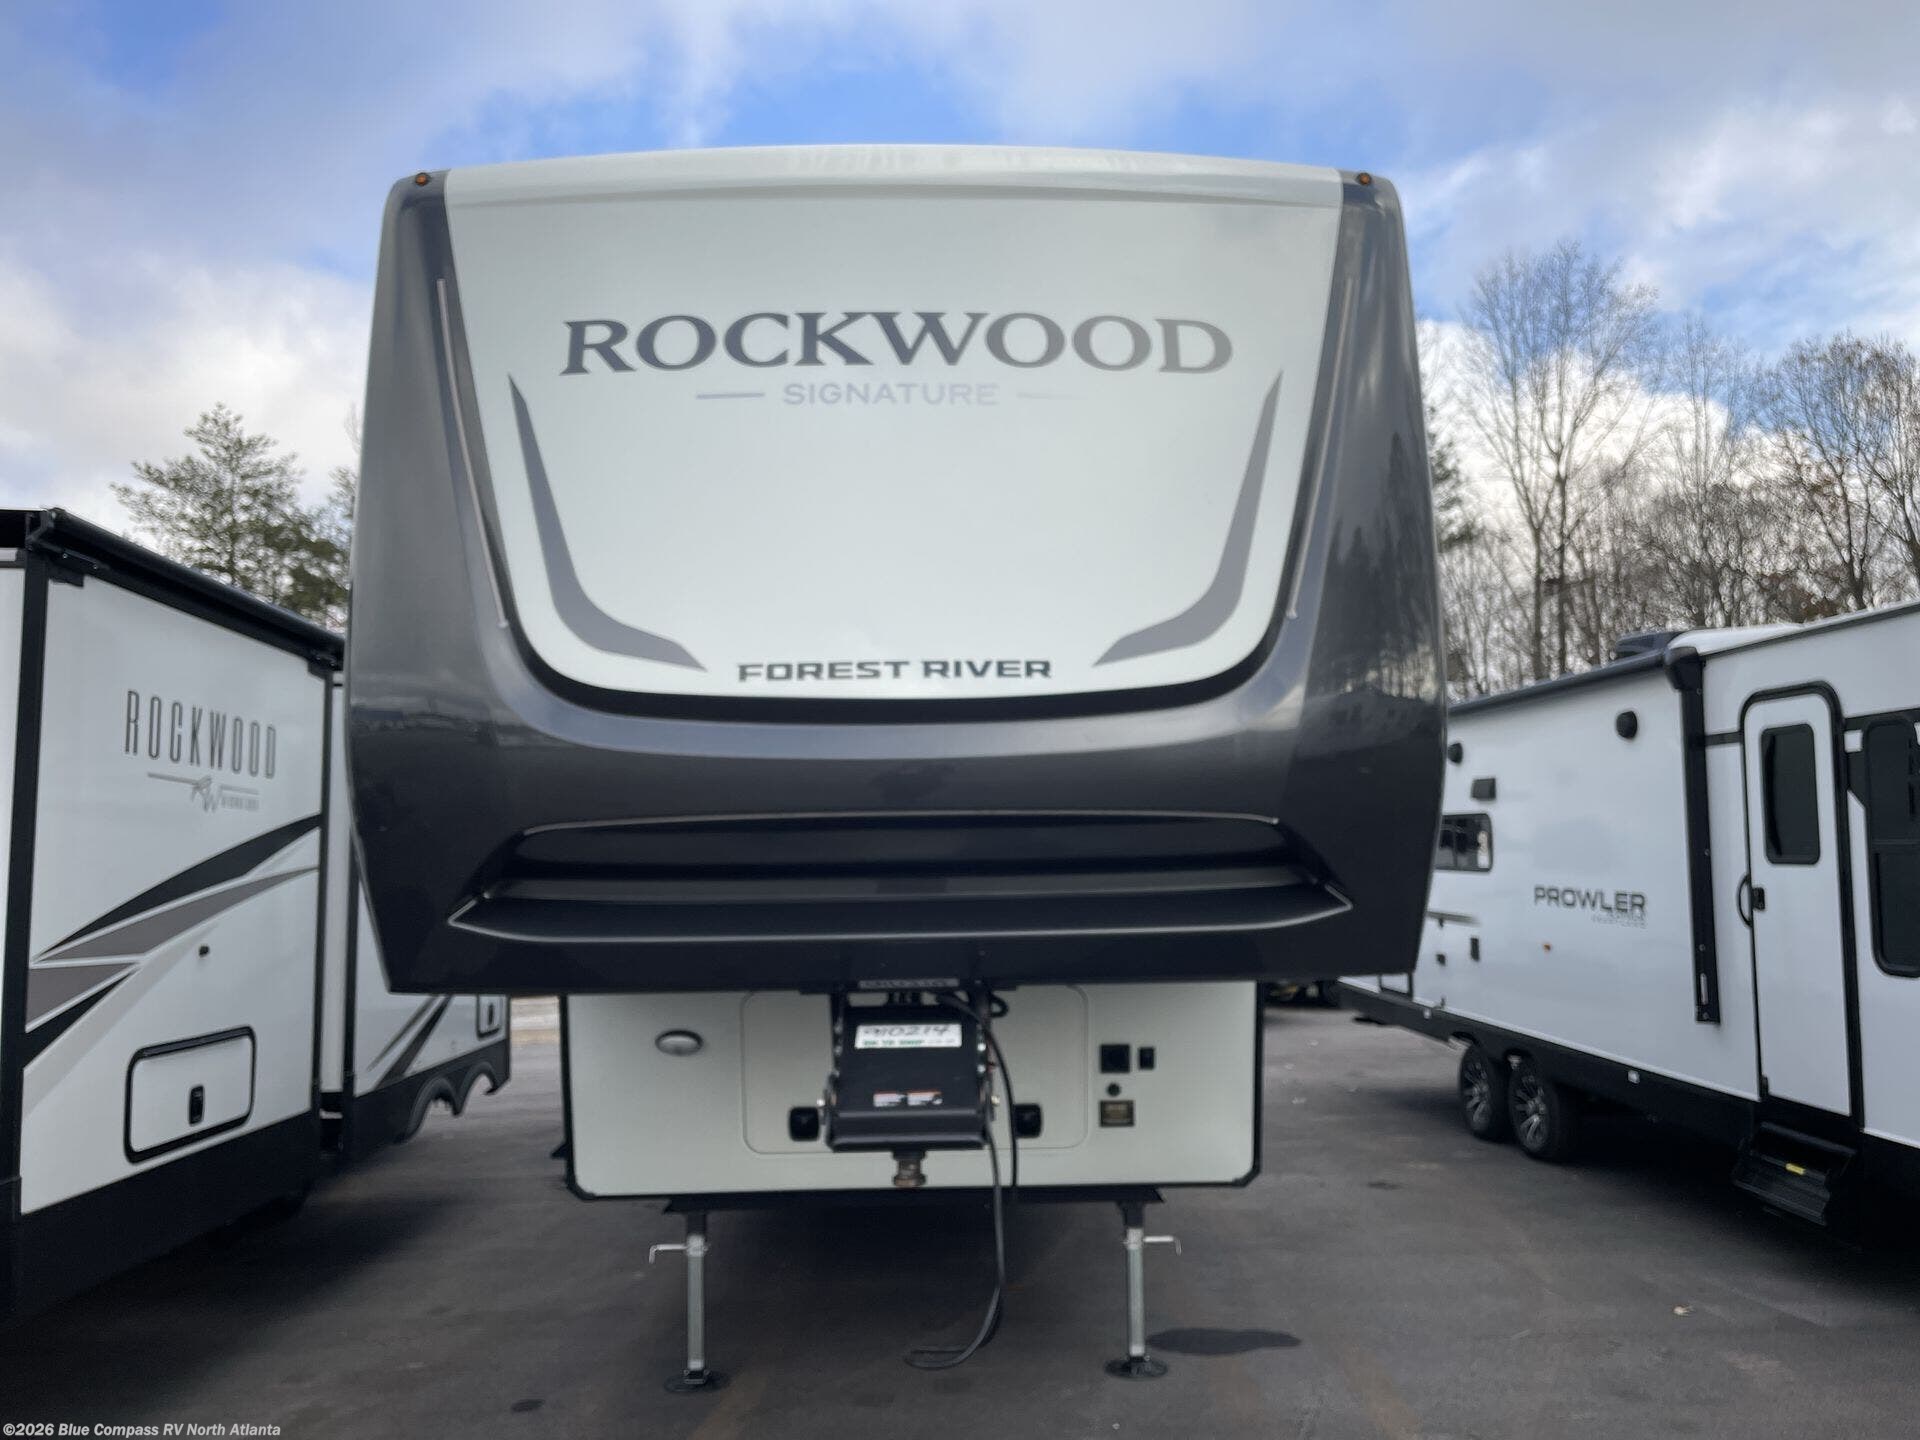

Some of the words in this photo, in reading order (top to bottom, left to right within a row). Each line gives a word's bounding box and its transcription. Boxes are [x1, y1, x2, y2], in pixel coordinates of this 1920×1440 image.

[559, 311, 1232, 375] ROCKWOOD
[783, 382, 999, 405] SIGNATURE
[738, 661, 909, 682] FOREST
[921, 660, 1051, 679] RIVER
[124, 690, 277, 779] ROCKWOOD
[1534, 886, 1646, 913] PROWLER
